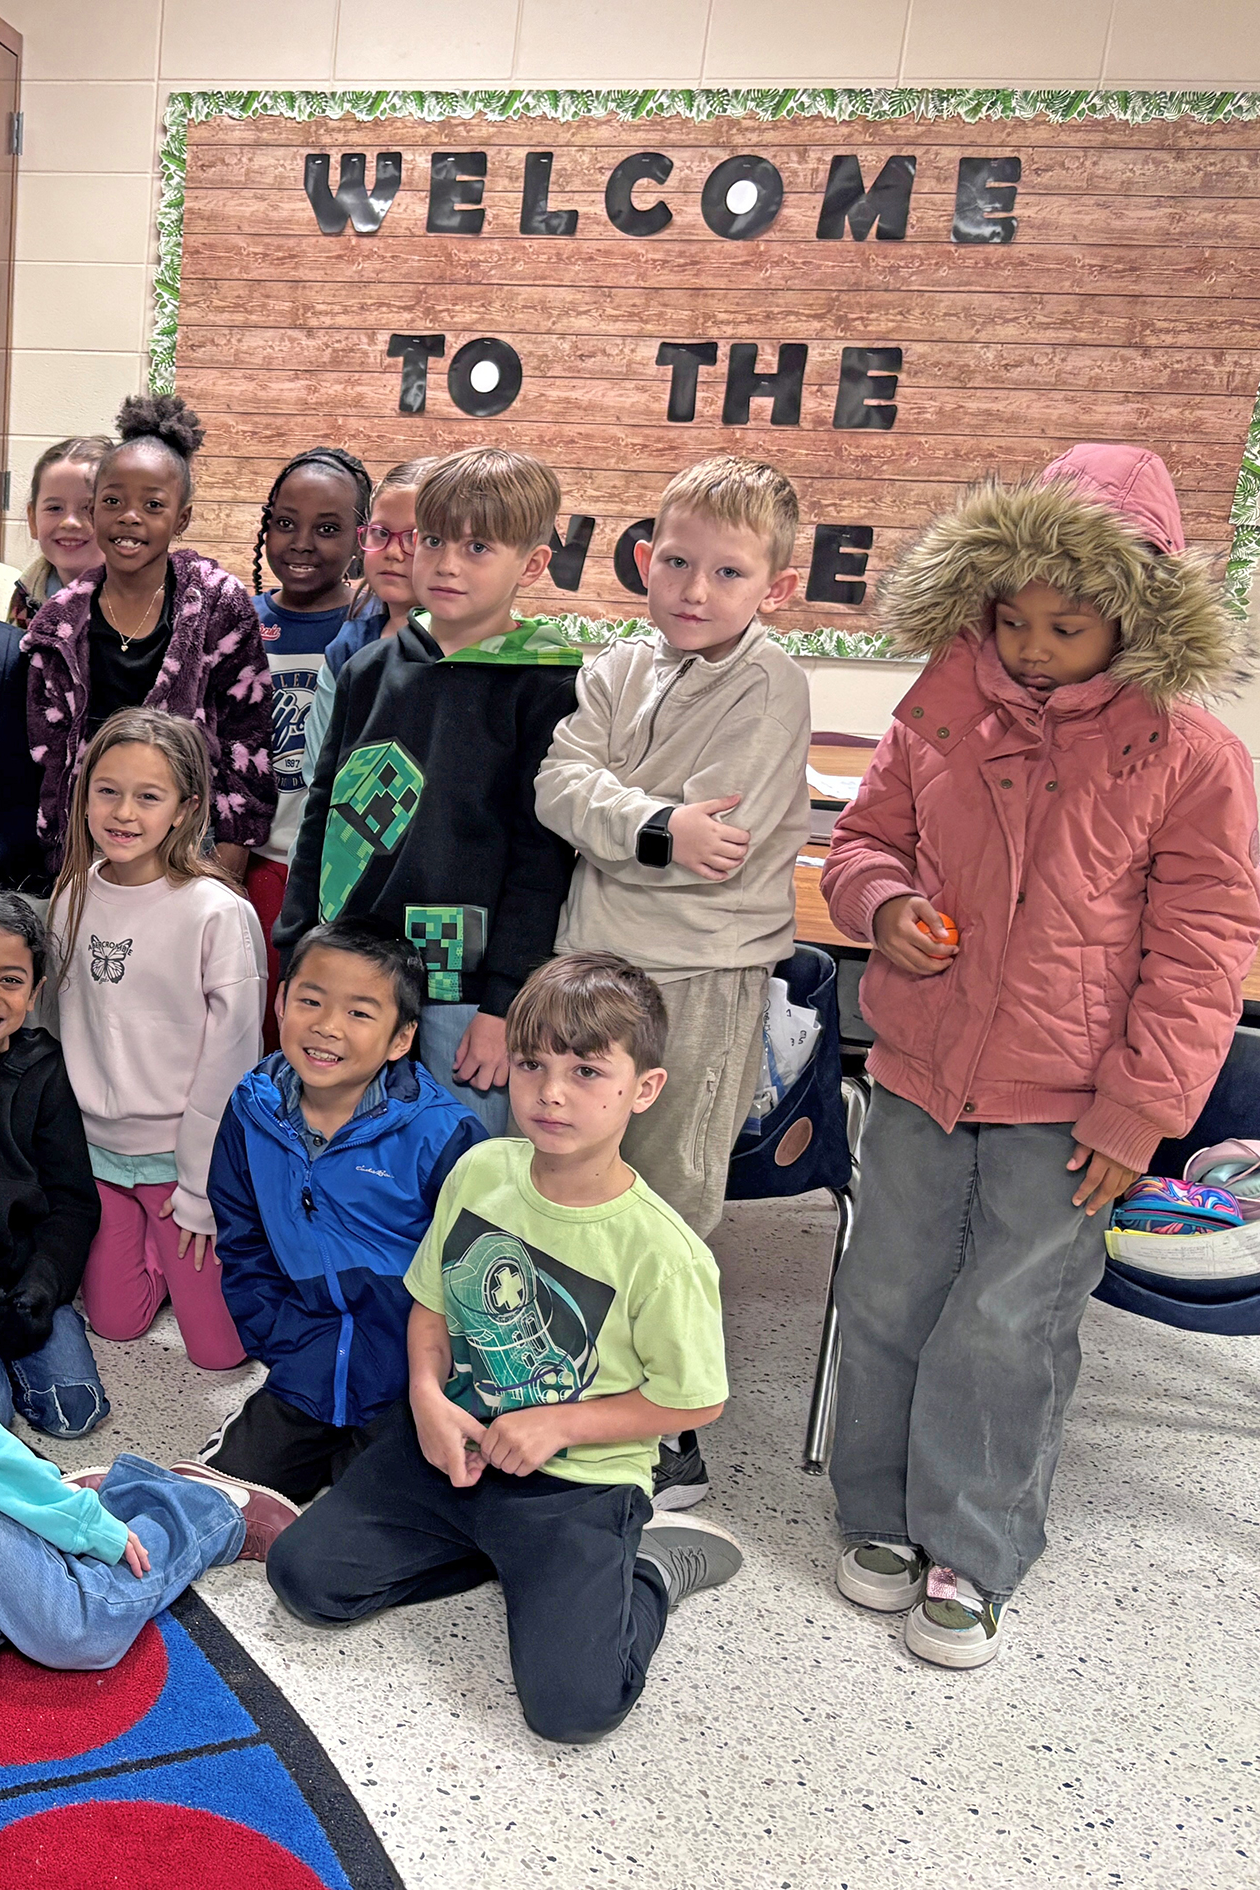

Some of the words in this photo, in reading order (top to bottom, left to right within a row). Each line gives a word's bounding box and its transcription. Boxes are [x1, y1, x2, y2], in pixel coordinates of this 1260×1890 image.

[304, 151, 1022, 243] WELCOME
[386, 333, 522, 417] TO
[655, 342, 902, 429] THE
